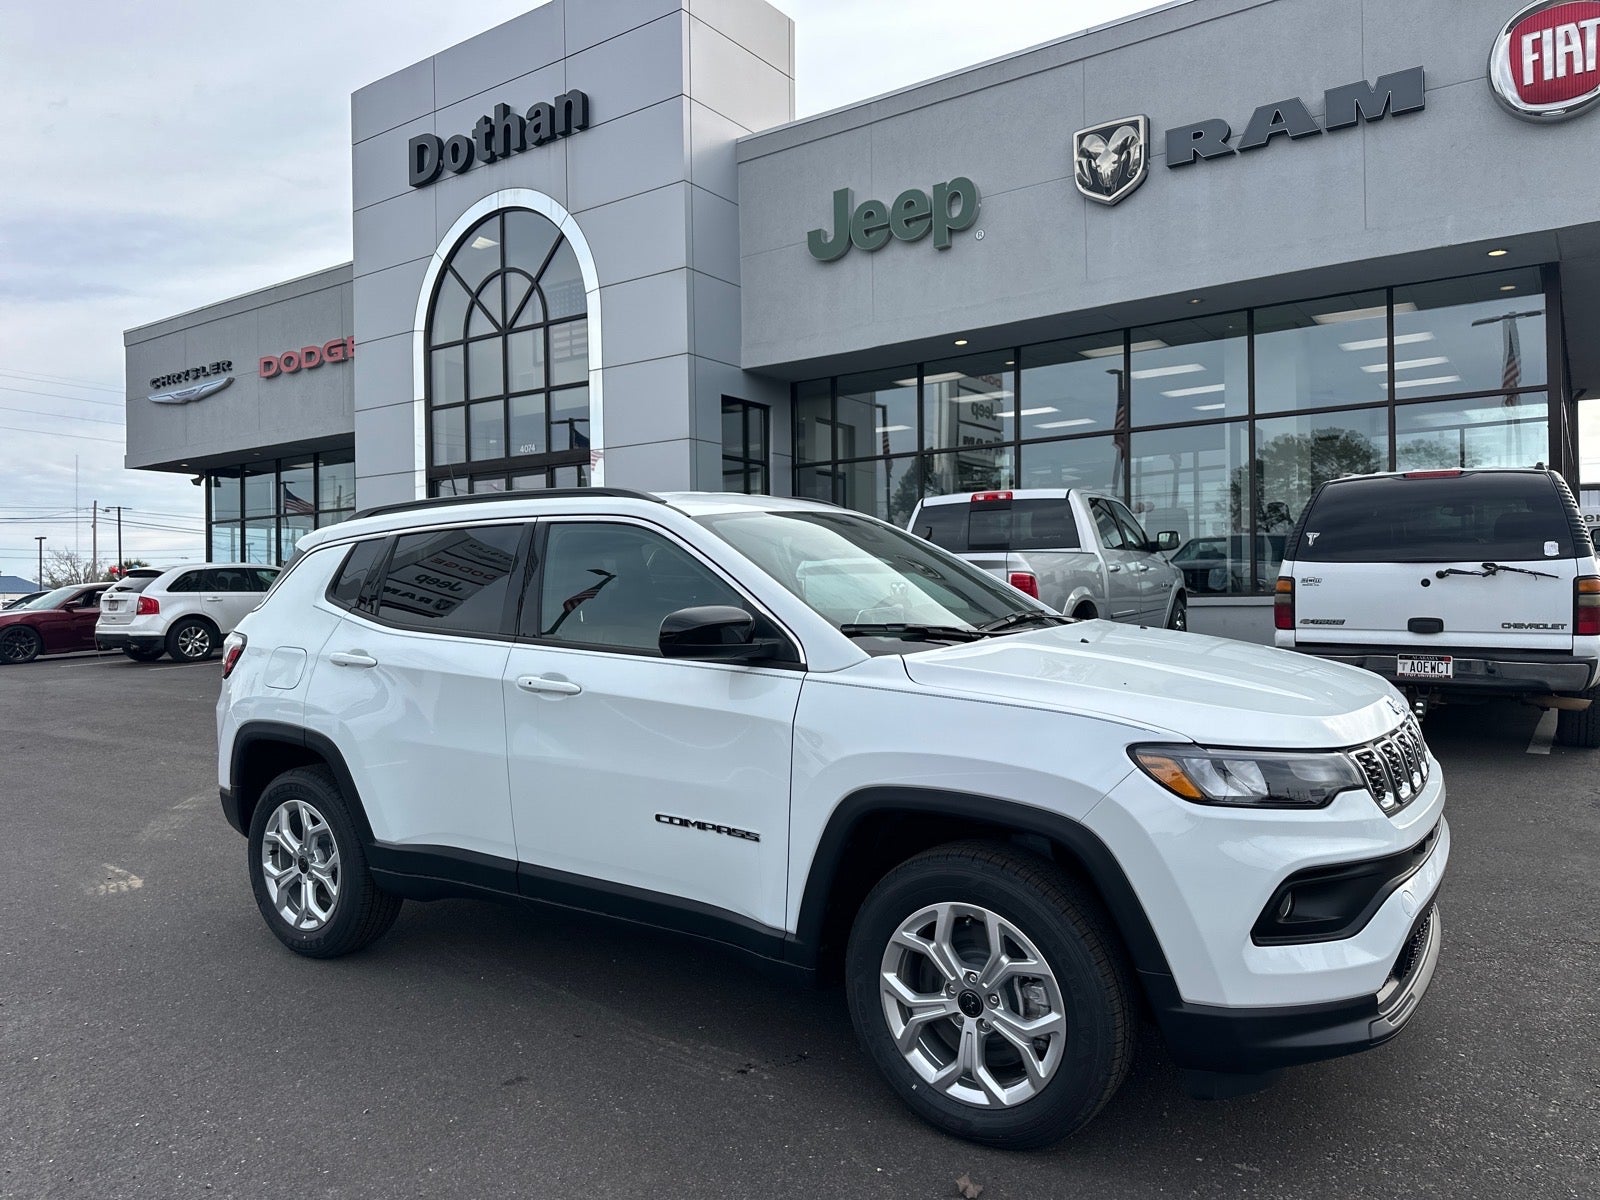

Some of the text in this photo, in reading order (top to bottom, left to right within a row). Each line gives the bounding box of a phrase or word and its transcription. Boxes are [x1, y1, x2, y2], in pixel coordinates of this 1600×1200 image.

[1521, 17, 1600, 87] FIAT
[408, 89, 590, 189] Dothan
[1165, 65, 1426, 169] RAM
[807, 176, 982, 262] Jeep
[150, 359, 233, 390] CHRYSLER
[520, 443, 536, 453] 4074
[1501, 622, 1568, 630] CHEVROLET
[655, 813, 761, 843] COMPASS
